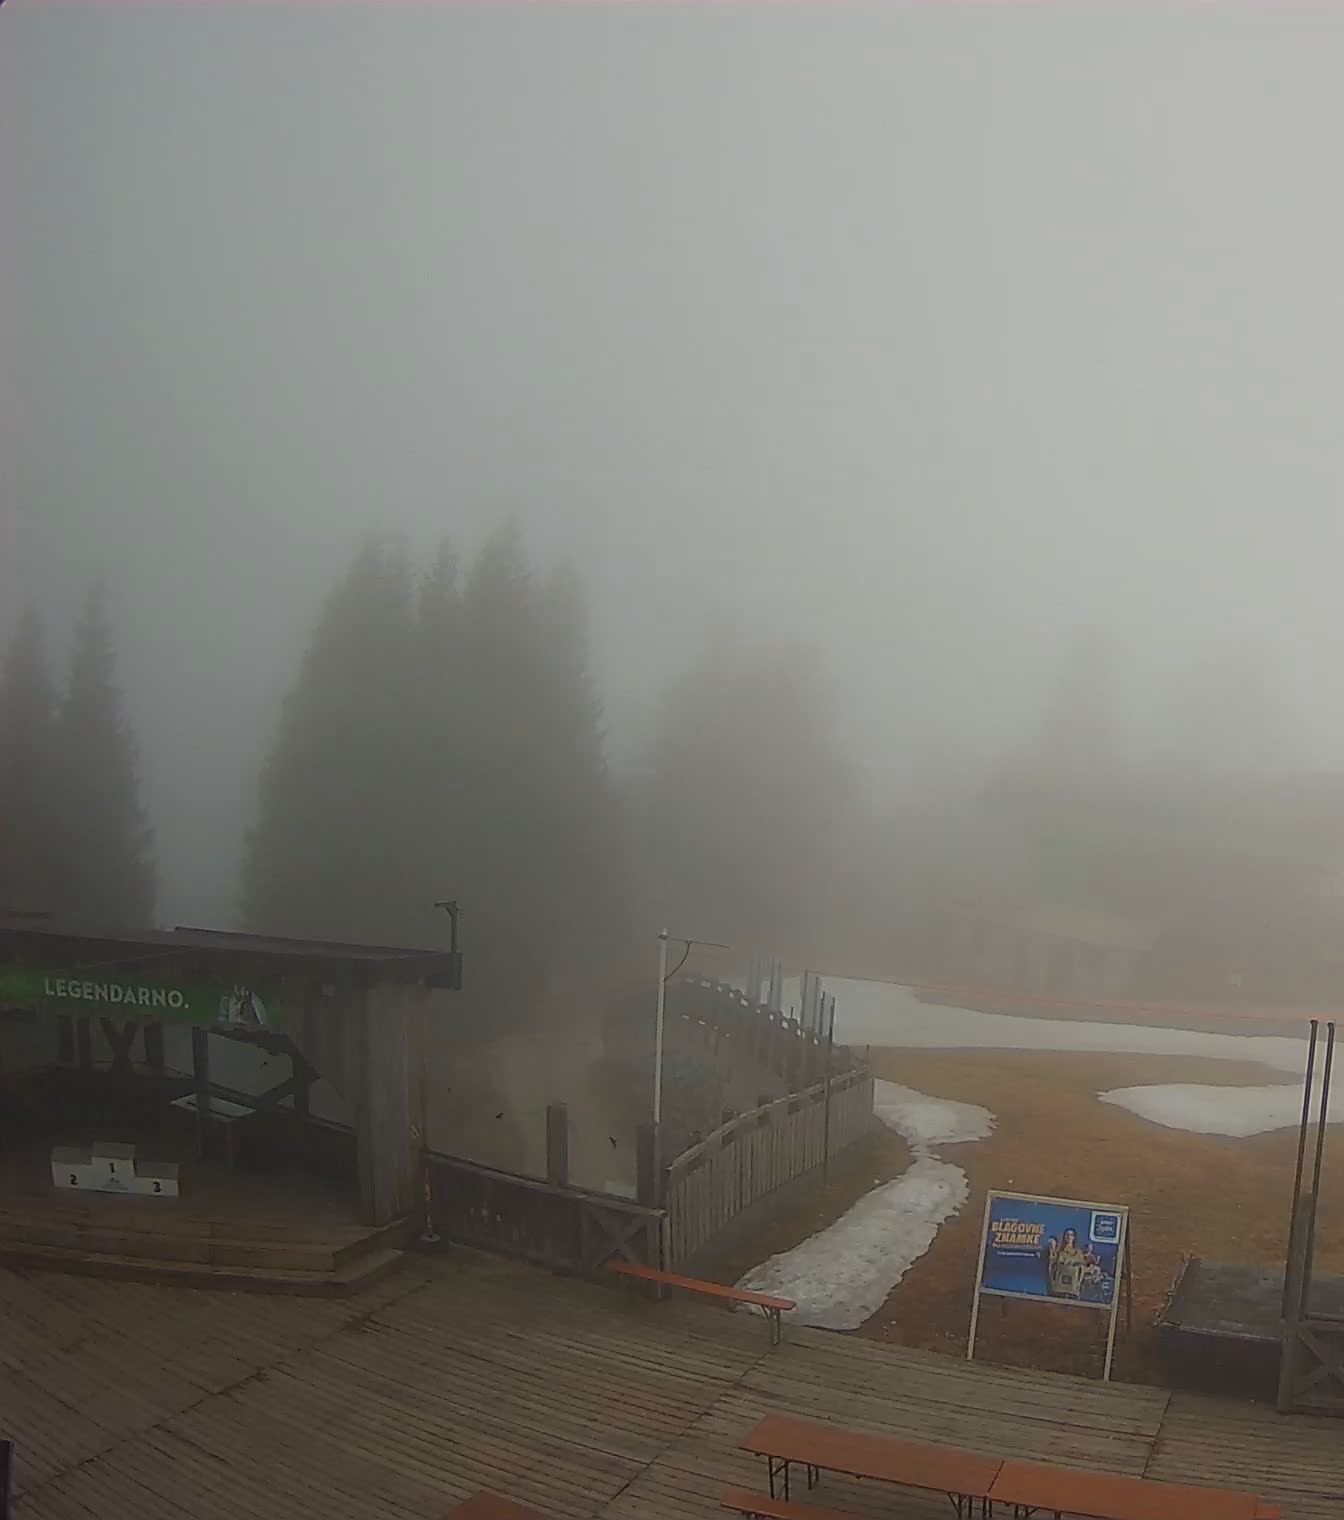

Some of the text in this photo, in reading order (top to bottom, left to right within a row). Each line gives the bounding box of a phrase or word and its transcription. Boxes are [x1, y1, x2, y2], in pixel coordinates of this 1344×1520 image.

[44, 977, 190, 1009] LEGENDARNO.
[109, 1162, 115, 1174] 1
[70, 1174, 78, 1186] 2
[152, 1181, 161, 1193] 3
[991, 1221, 1045, 1234] BLAGOVNE
[994, 1232, 1041, 1245] ZNAMKE
